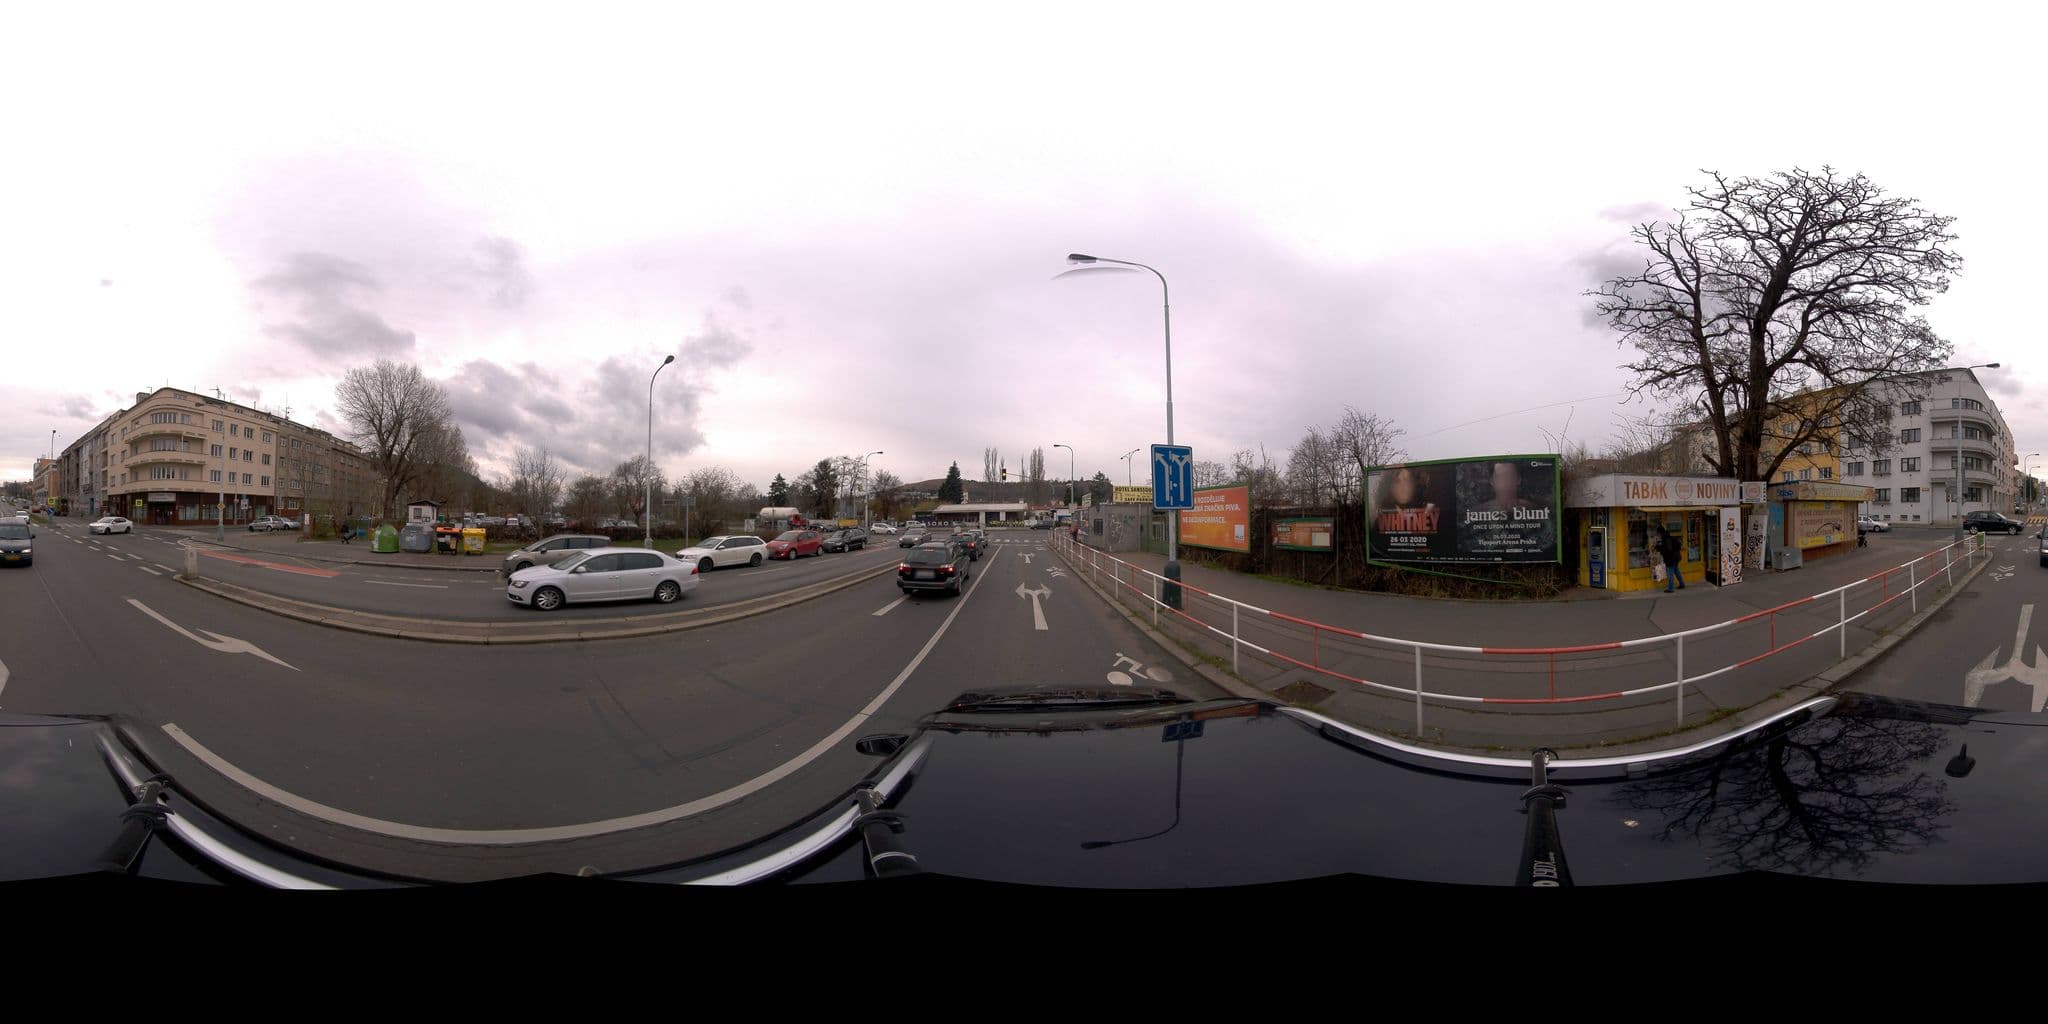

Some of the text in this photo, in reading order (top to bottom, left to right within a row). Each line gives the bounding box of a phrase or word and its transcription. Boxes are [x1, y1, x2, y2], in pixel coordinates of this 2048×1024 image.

[1624, 480, 1668, 499] TABÁK
[1696, 483, 1737, 500] NOVINY
[1378, 509, 1440, 531] WHITNEY
[1464, 506, 1551, 525] james blunt
